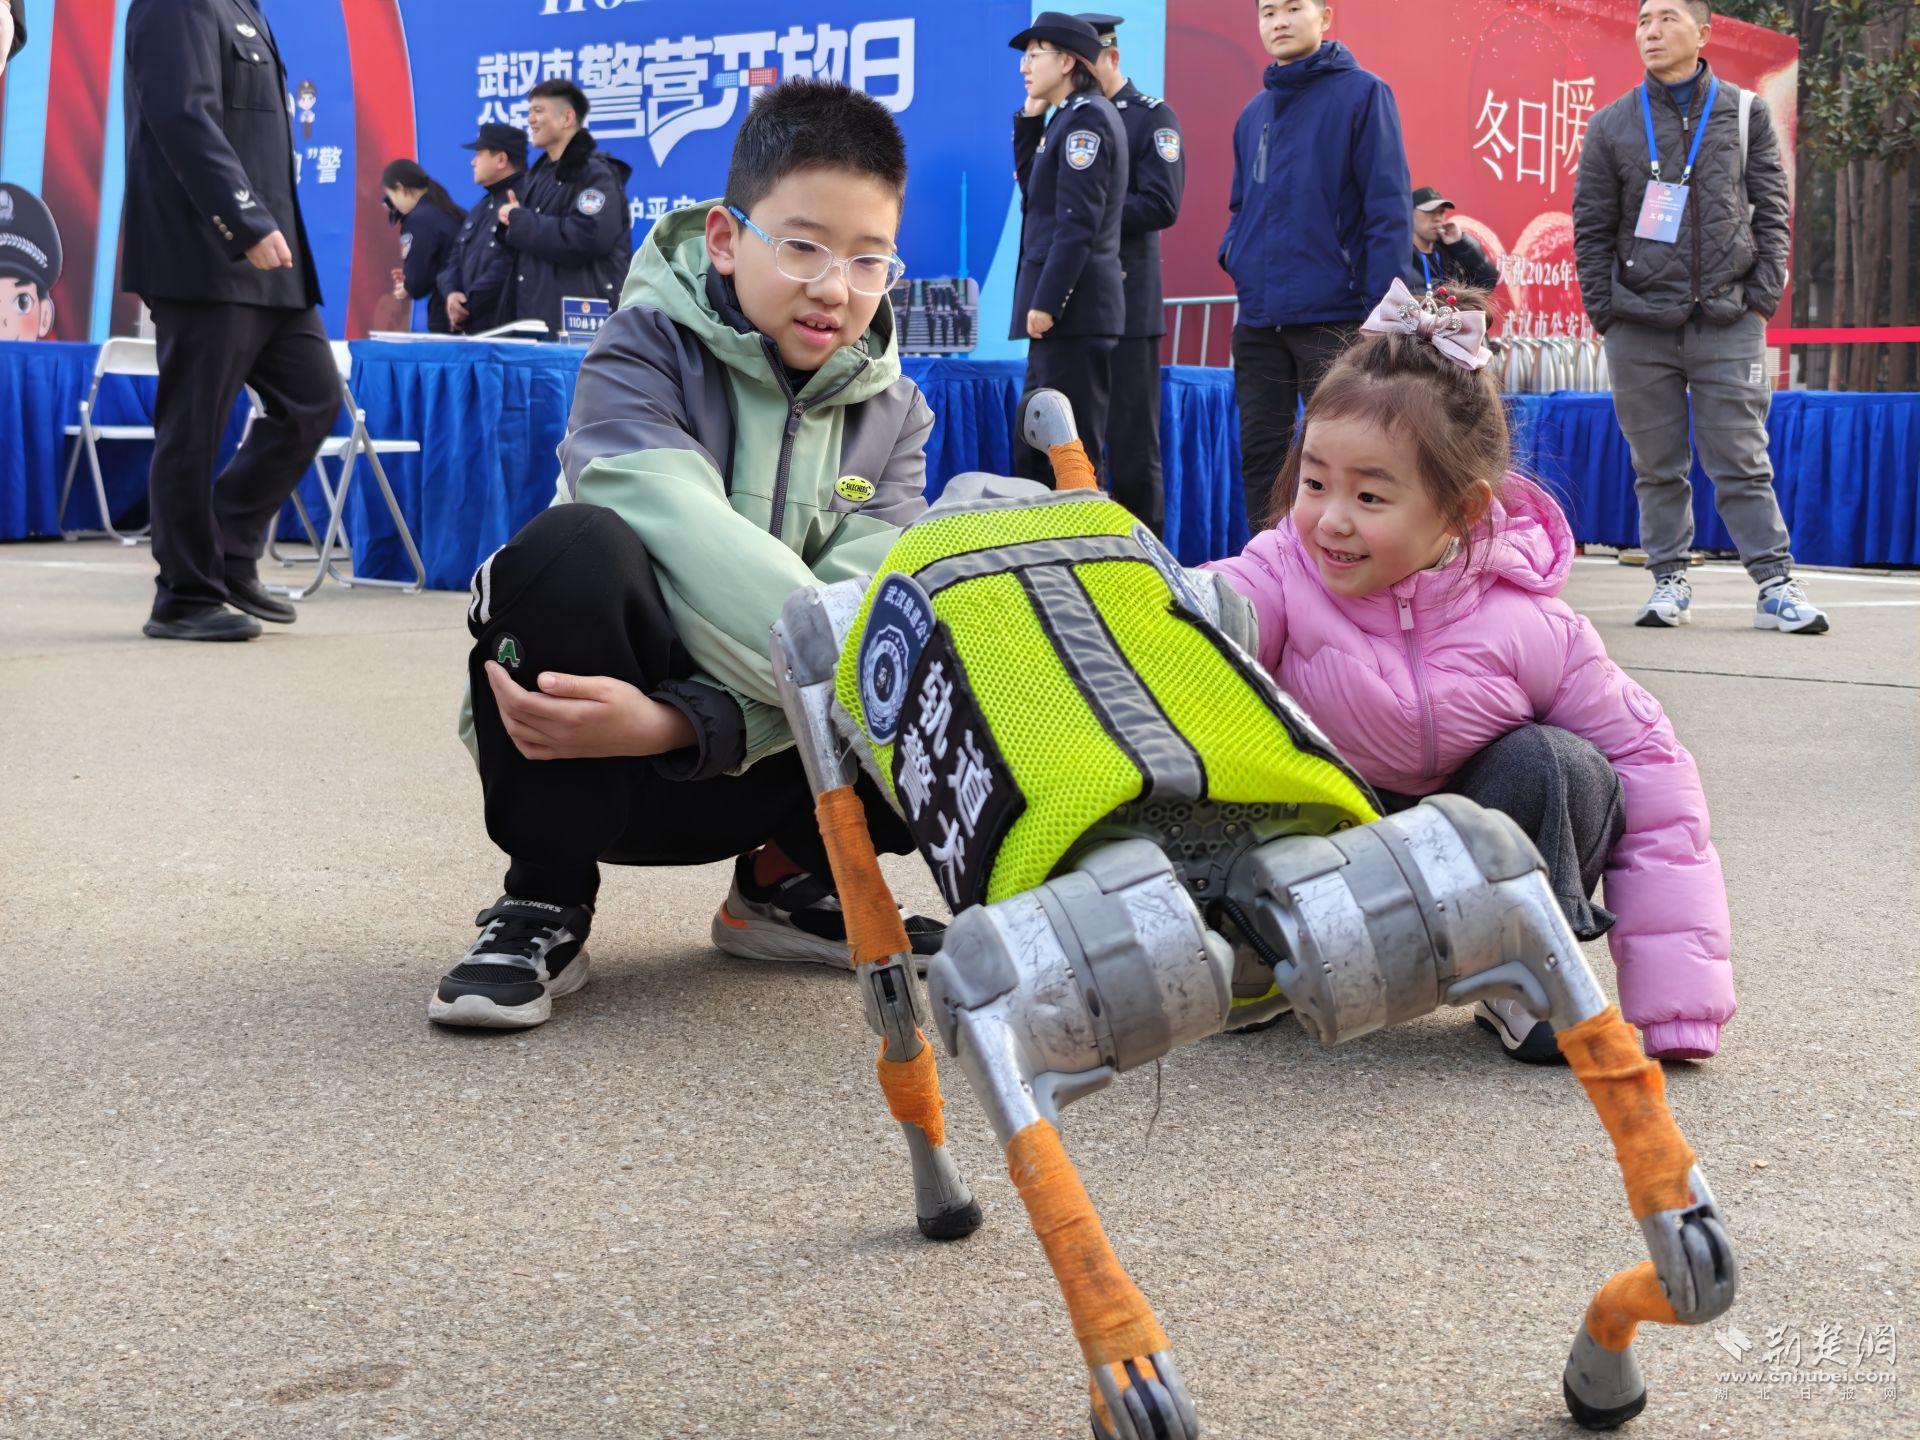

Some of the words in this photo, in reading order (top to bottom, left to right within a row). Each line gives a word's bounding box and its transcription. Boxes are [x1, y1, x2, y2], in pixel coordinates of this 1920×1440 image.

[1472, 76, 1596, 194] 冬日暖
[845, 482, 869, 493] SKECHERS
[503, 899, 564, 914] SKECHERS
